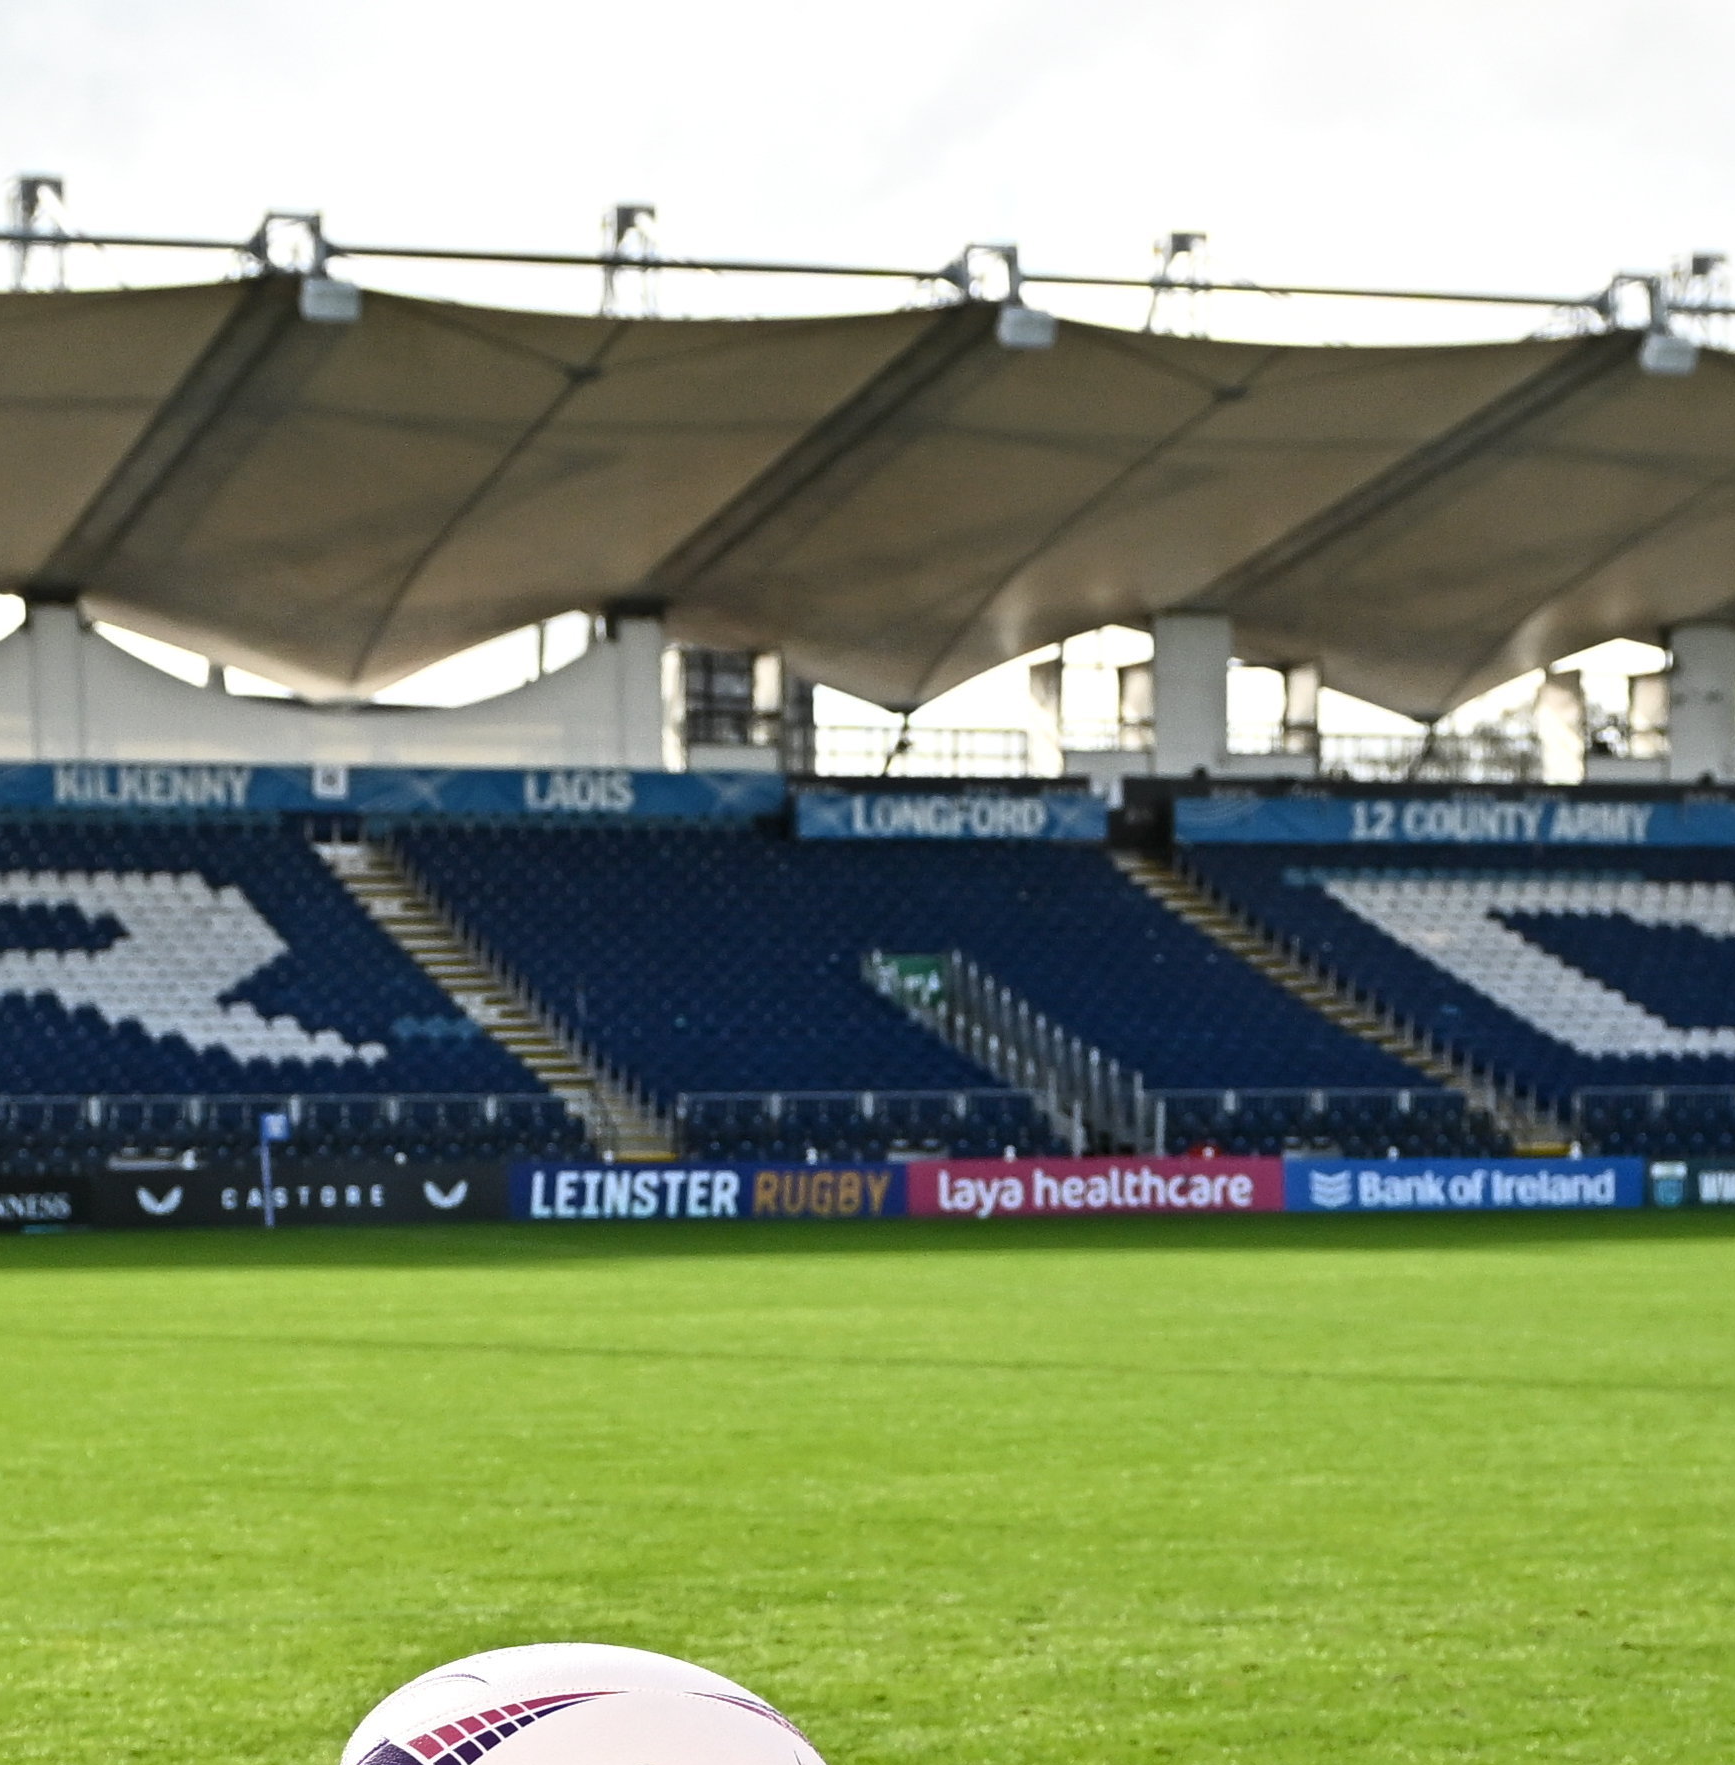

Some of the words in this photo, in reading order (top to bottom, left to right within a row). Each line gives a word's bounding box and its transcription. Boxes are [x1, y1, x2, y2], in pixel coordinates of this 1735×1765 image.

[54, 764, 251, 807] KILKENNY
[524, 771, 635, 812] LAOIS
[853, 796, 1046, 838] LONGFORD
[1349, 801, 1395, 841] 12
[1400, 800, 1545, 842] COUNTY
[1549, 801, 1653, 842] ARMY
[221, 1184, 385, 1209] CASTORE
[531, 1170, 740, 1219] LEINSTER
[752, 1170, 891, 1214] RUGBY
[937, 1169, 1024, 1218] laya
[1033, 1166, 1253, 1208] healthcare
[1358, 1170, 1446, 1207] Bank
[1448, 1168, 1487, 1207] of
[1491, 1168, 1615, 1207] Ireland
